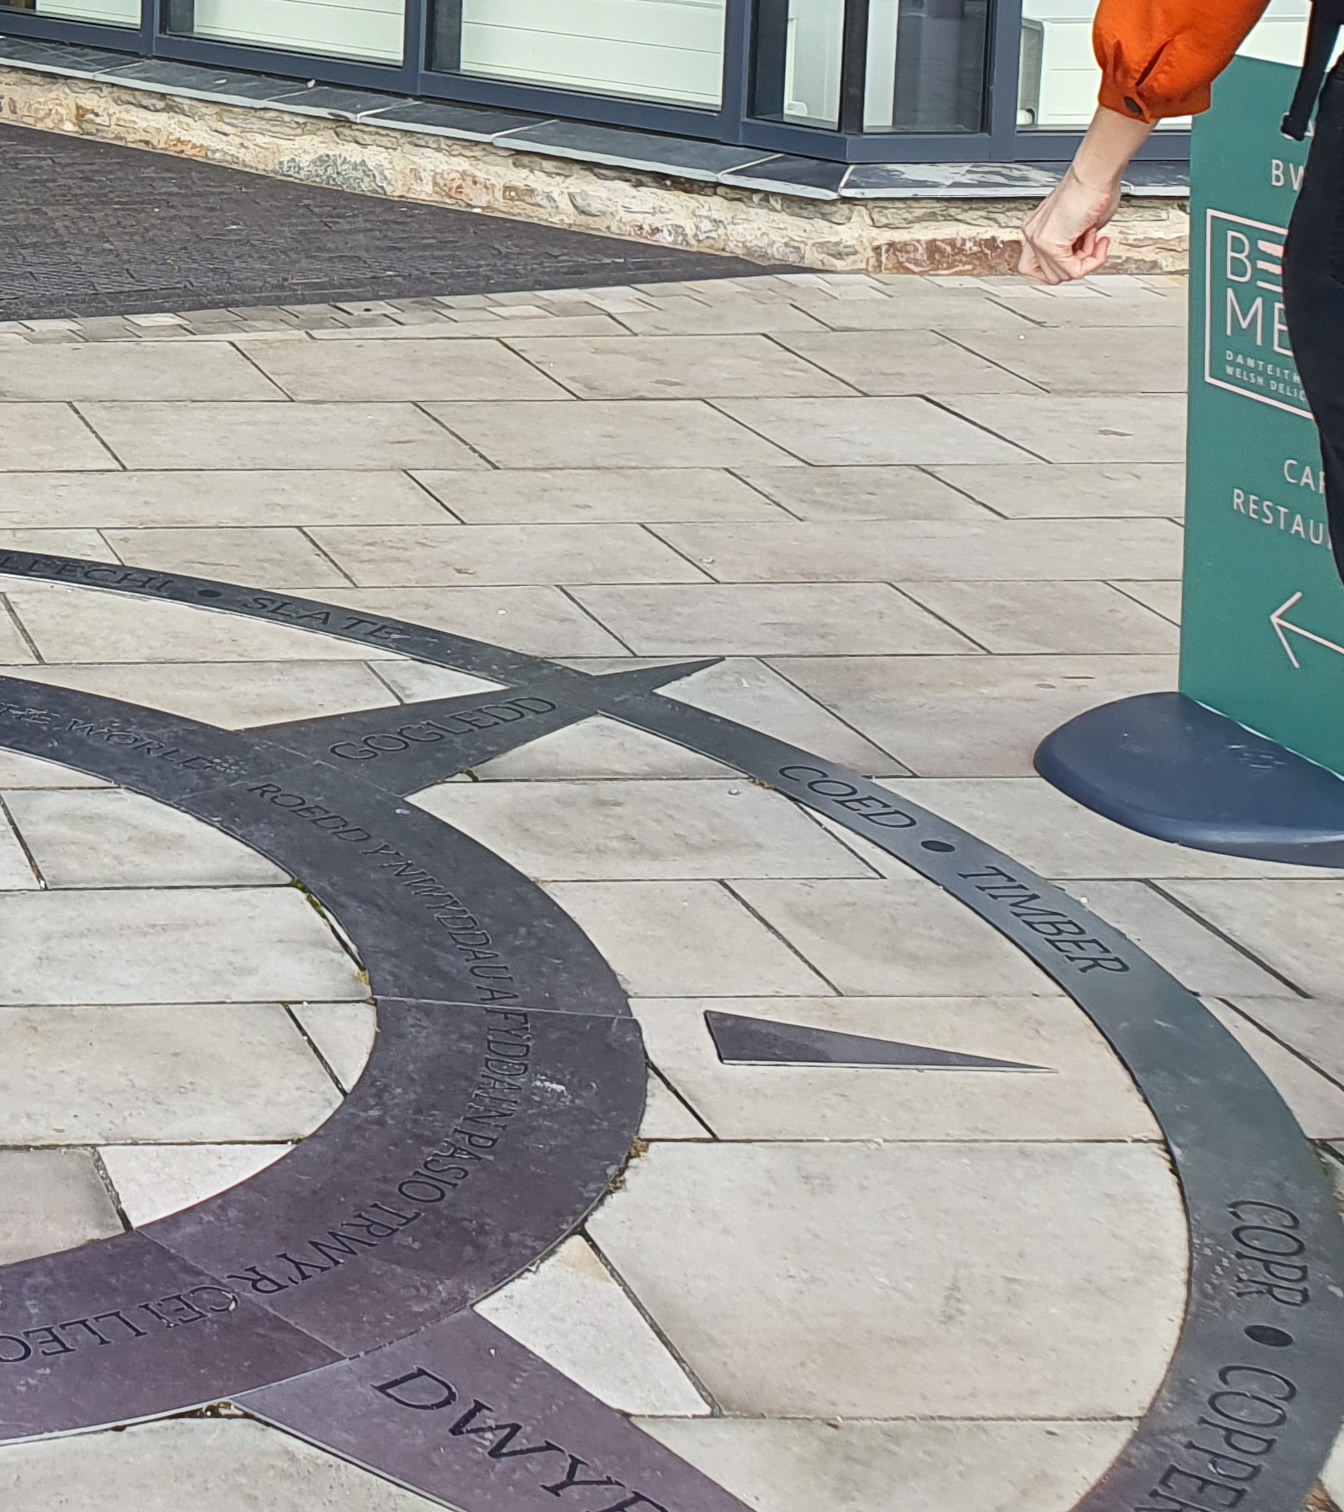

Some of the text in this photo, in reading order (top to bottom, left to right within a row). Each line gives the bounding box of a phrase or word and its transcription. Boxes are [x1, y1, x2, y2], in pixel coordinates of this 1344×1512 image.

[1225, 349, 1302, 383] DANTEITH
[1225, 364, 1307, 402] WELSH DELIC
[1232, 488, 1332, 551] RESTAU
[241, 596, 409, 640] SLATE
[329, 696, 558, 761] GOGLEDD
[248, 783, 372, 843] ROEDD
[777, 765, 1131, 975] COED TIMBER
[378, 859, 514, 981] NWYDDAU
[397, 1127, 499, 1204] PASIO
[1226, 1199, 1311, 1307] COPR
[138, 1285, 239, 1329] CEI
